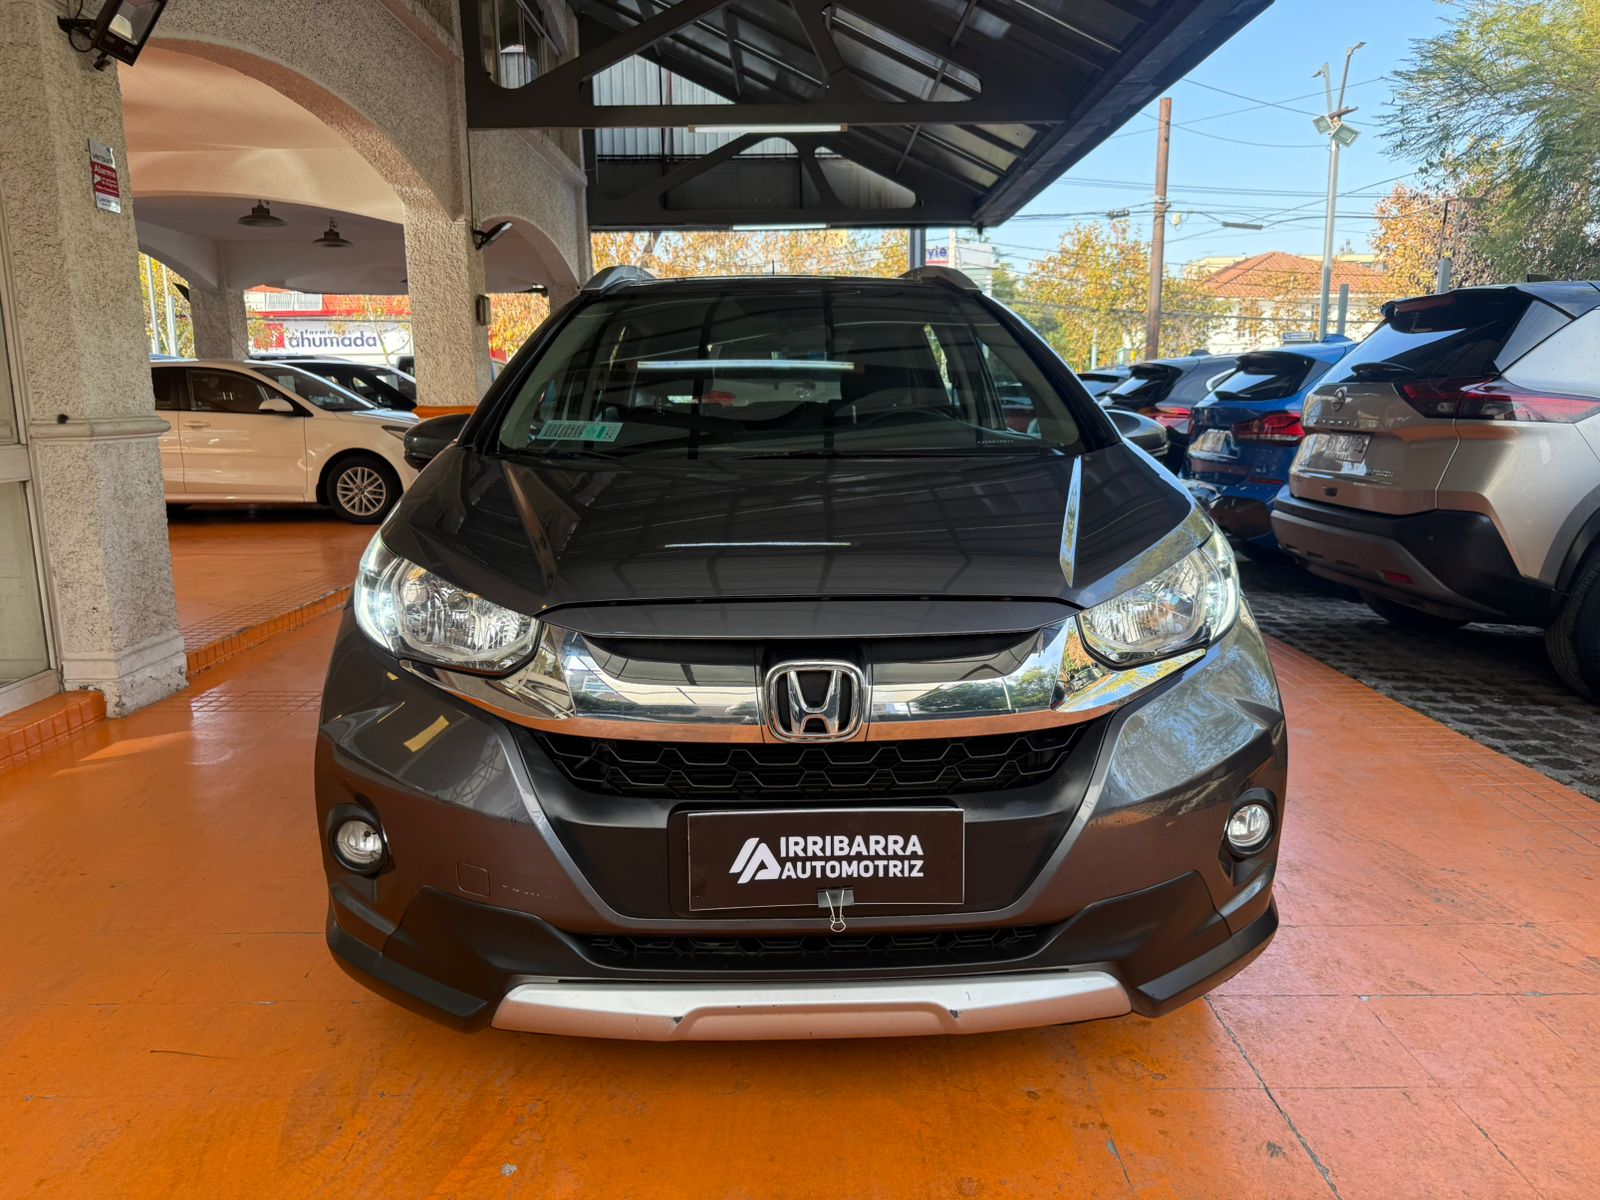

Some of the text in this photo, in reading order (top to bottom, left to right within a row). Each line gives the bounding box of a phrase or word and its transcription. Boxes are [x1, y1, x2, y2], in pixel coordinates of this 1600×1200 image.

[288, 330, 377, 348] ahumada
[780, 834, 924, 857] IRRIBARRA
[781, 860, 924, 880] AUTOMOTRIZ
